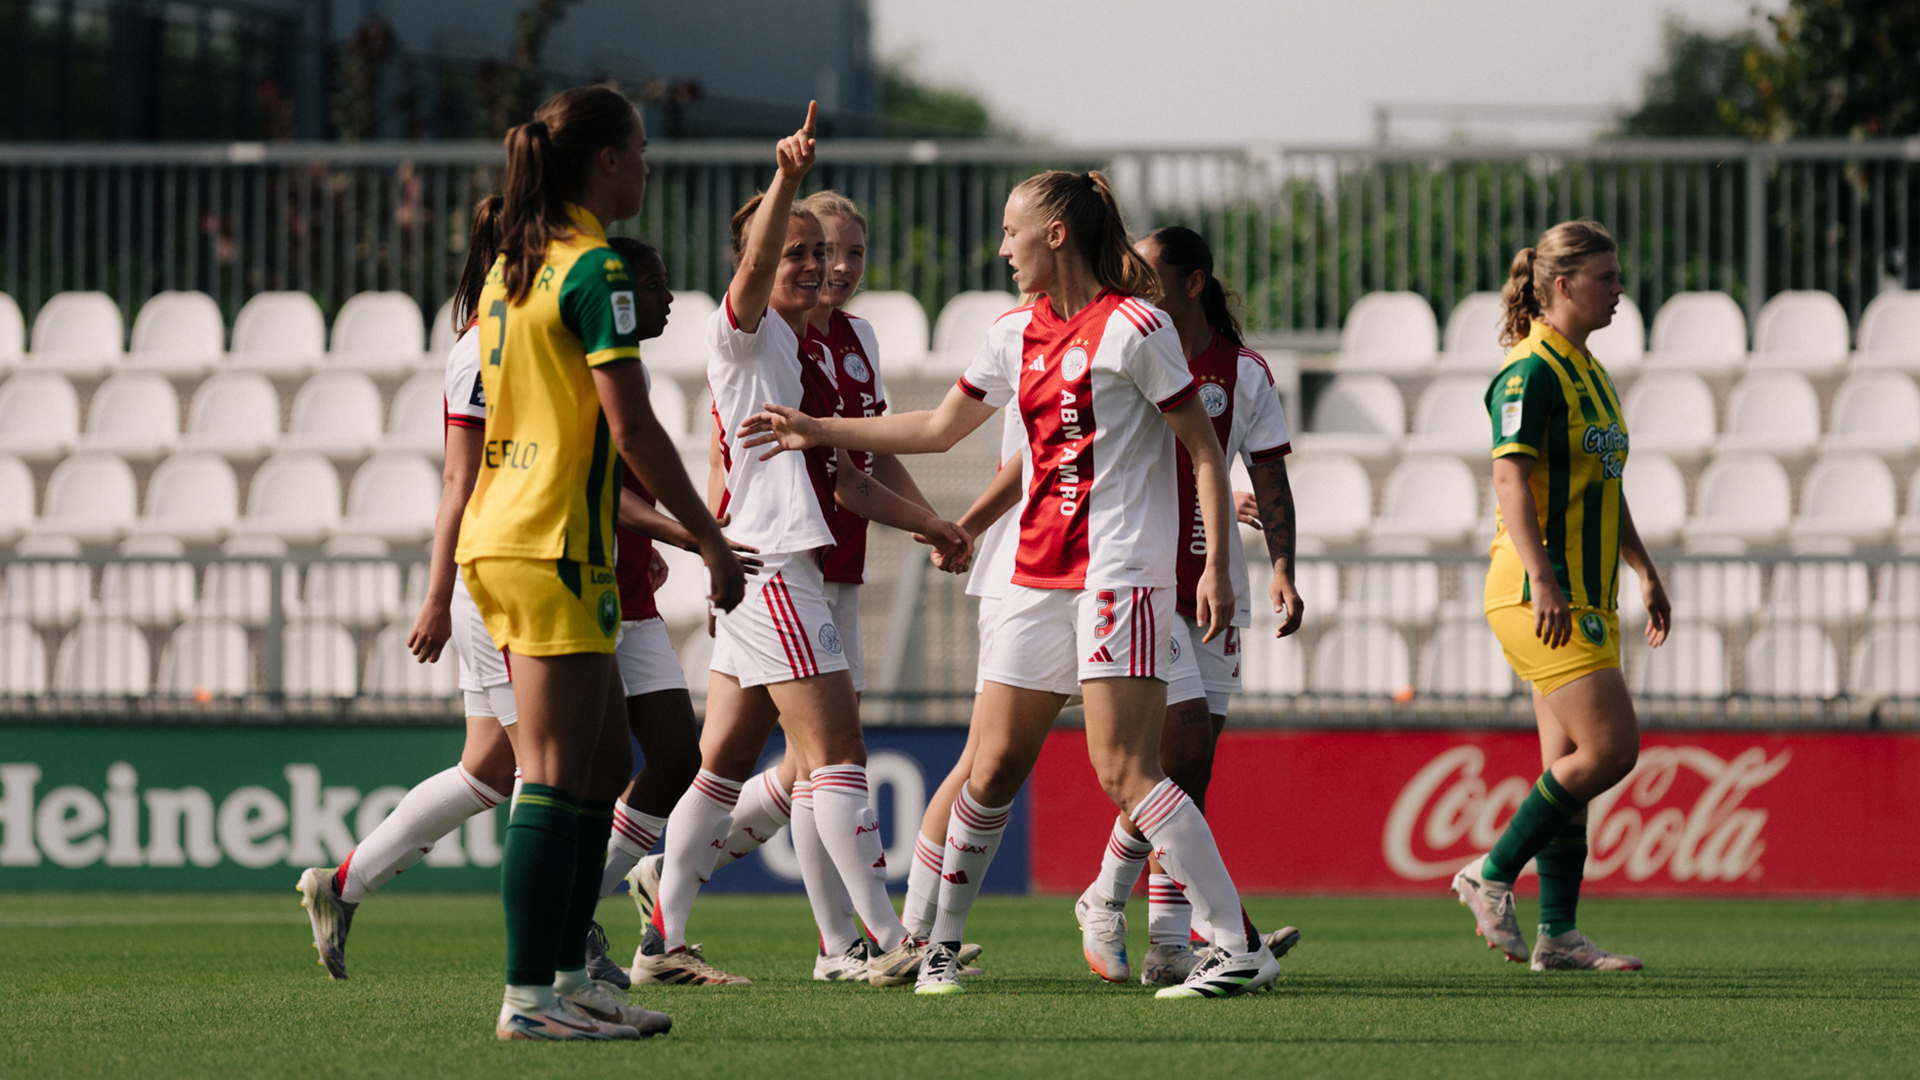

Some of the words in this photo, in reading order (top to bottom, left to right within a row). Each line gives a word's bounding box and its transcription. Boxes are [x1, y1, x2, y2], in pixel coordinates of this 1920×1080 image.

[1058, 446, 1080, 516] AMRO
[1094, 589, 1117, 639] 3
[1382, 744, 1792, 882] CocCola
[948, 835, 988, 855] AJAX
